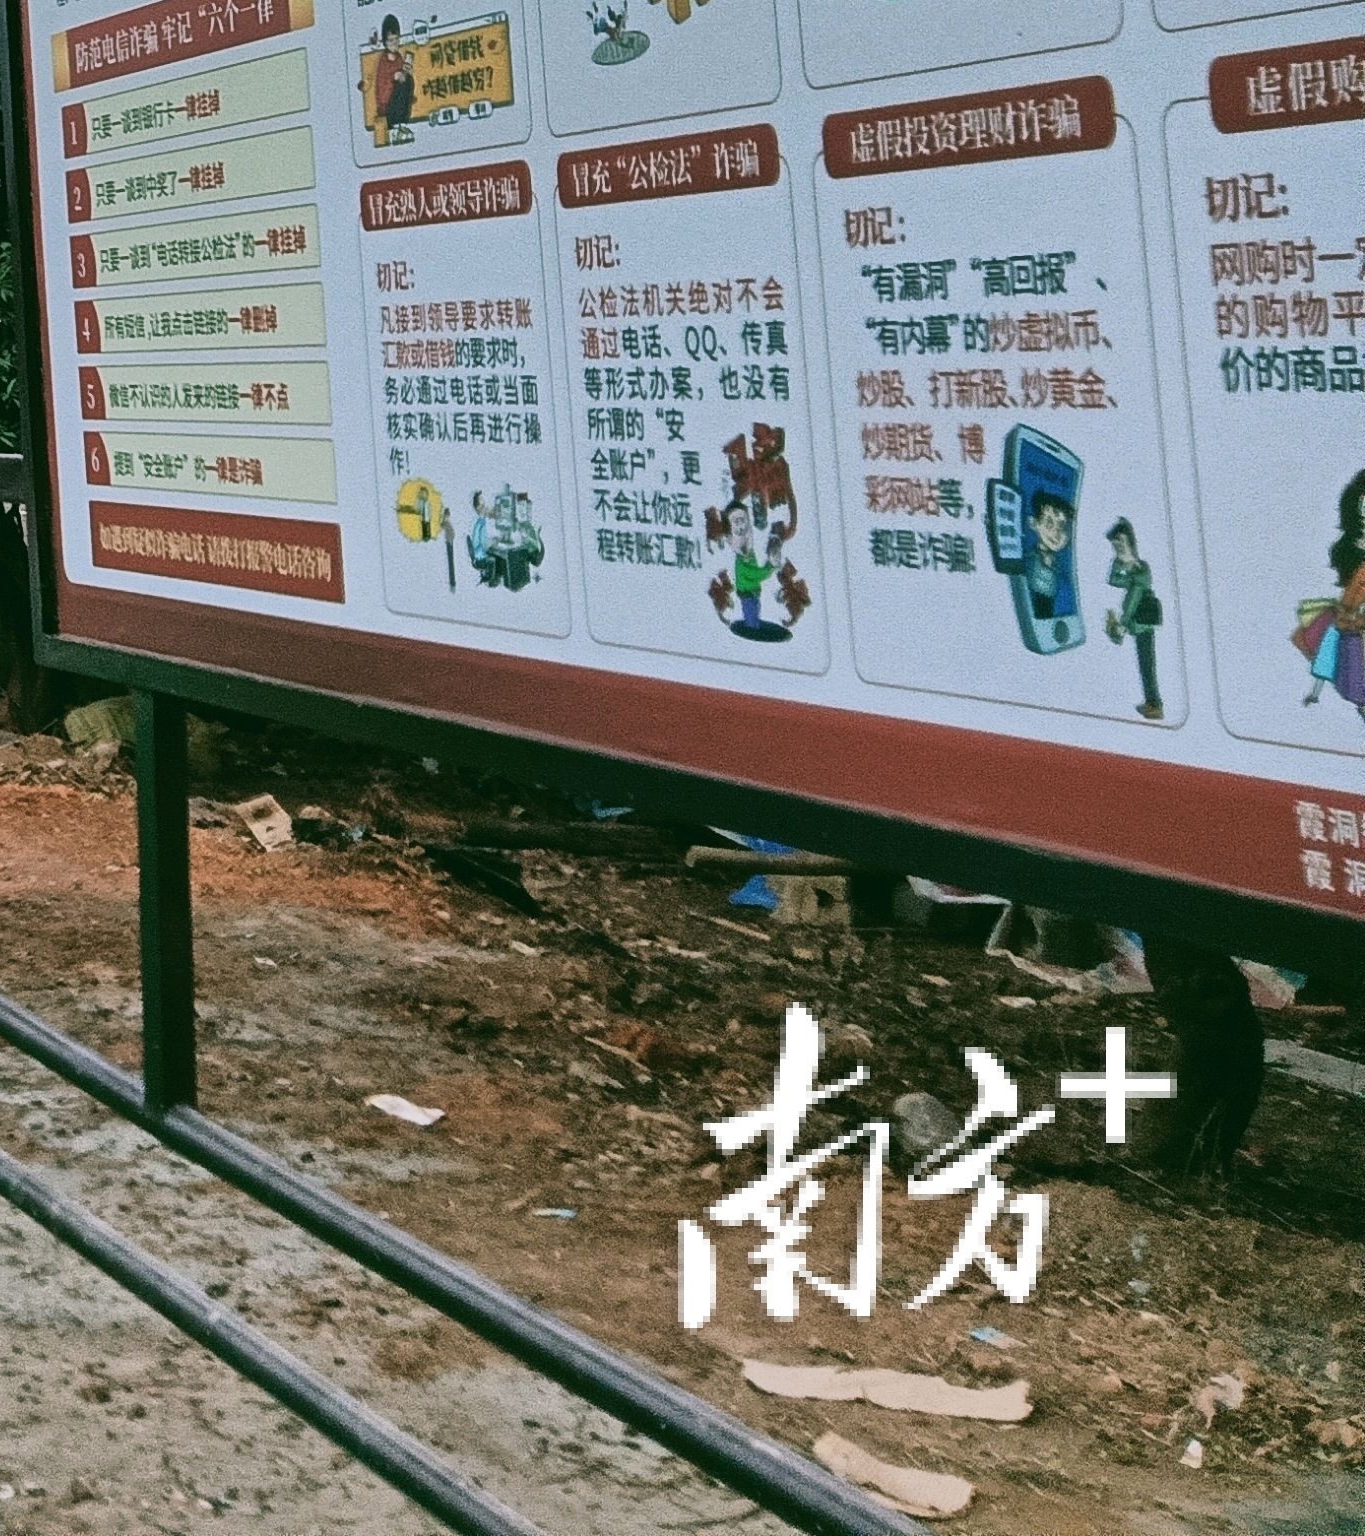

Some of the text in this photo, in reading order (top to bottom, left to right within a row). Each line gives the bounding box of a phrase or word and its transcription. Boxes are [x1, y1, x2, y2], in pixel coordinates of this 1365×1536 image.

[70, 120, 78, 146] 1
[849, 93, 1082, 164] 虚假投资理财诈骗
[72, 186, 83, 212] 2
[368, 176, 521, 226] 冒充熟人或领导诈骗
[77, 253, 87, 278] 3
[1210, 235, 1365, 287] 网购时一
[578, 276, 785, 319] 公检法机关绝对不会
[81, 321, 91, 342] 4
[380, 298, 533, 334] 凡接到领导要求转账
[85, 384, 96, 410] 5
[383, 374, 540, 407] 务必通过电话或当面
[388, 411, 542, 444] 核实确认后再进行操
[91, 448, 100, 473] 6
[593, 490, 693, 528] 不会让你远
[870, 528, 977, 573] 都是诈骗
[1292, 799, 1365, 849] 霞洞
